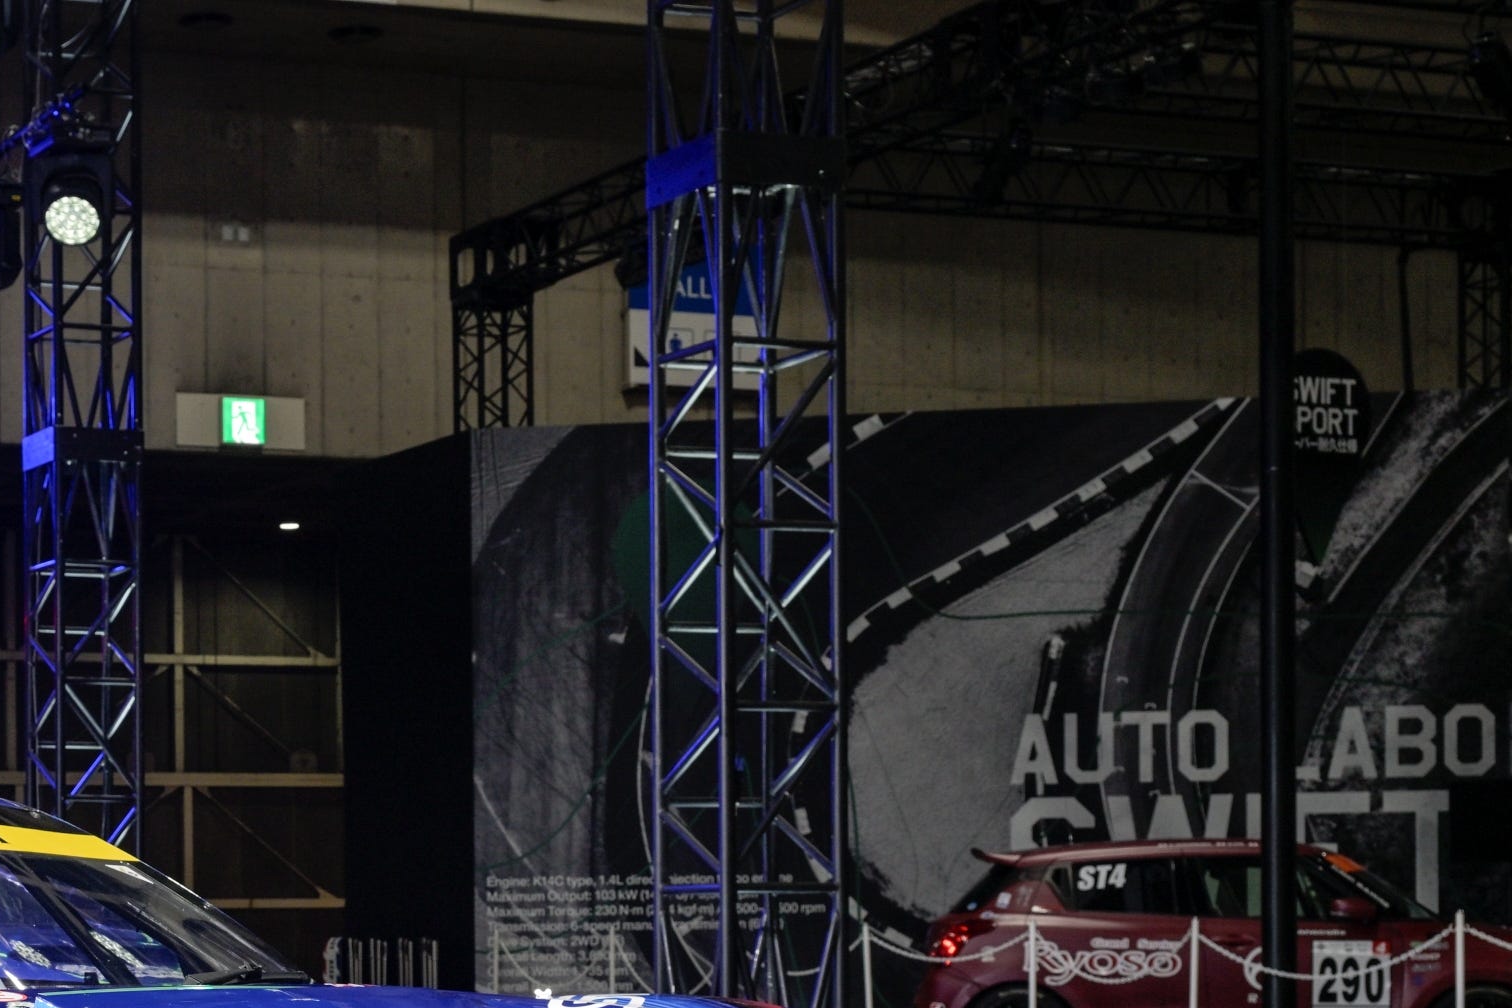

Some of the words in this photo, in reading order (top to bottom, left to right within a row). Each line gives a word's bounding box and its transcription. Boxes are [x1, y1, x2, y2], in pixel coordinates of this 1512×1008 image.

[674, 275, 713, 299] ALL
[1296, 406, 1358, 436] PORT
[1009, 709, 1229, 785] AUTO
[1295, 703, 1512, 781] ABO
[626, 875, 654, 886] direc
[1077, 863, 1127, 892] ST4
[1318, 956, 1384, 1003] 290
